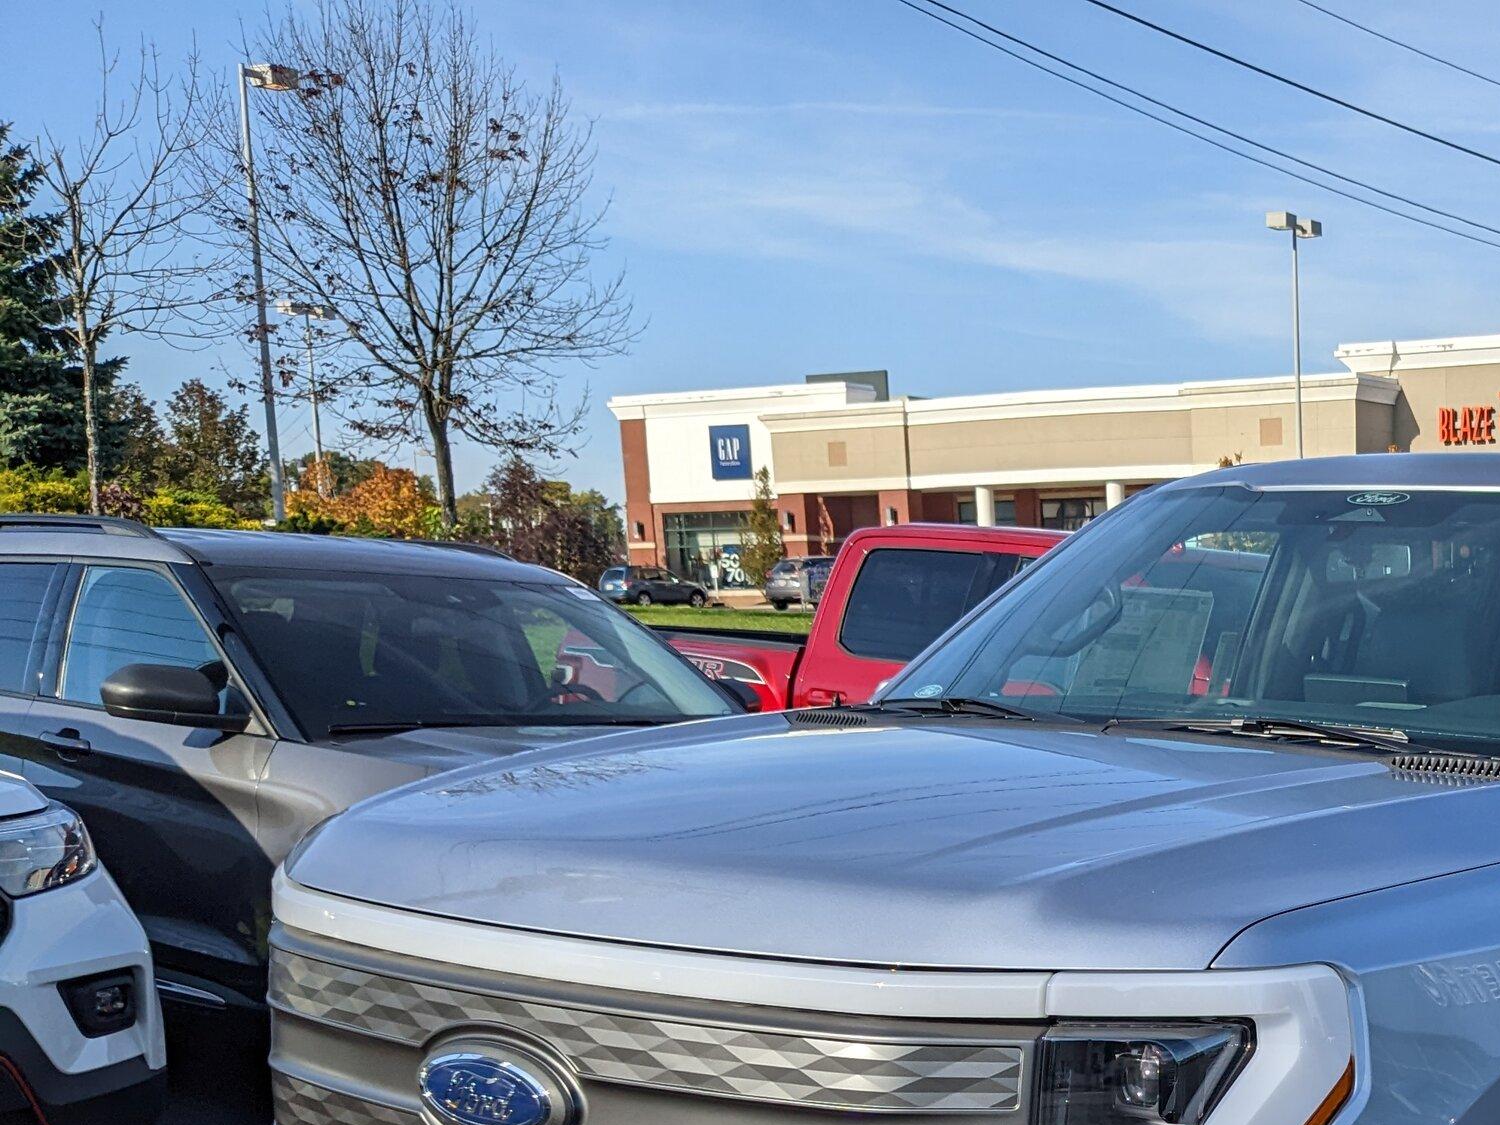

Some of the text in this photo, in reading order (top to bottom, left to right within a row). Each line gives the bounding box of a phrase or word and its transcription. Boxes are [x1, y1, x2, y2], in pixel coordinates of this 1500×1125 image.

[1438, 405, 1495, 443] BLAZE
[718, 437, 740, 461] GAP
[725, 568, 745, 582] 70
